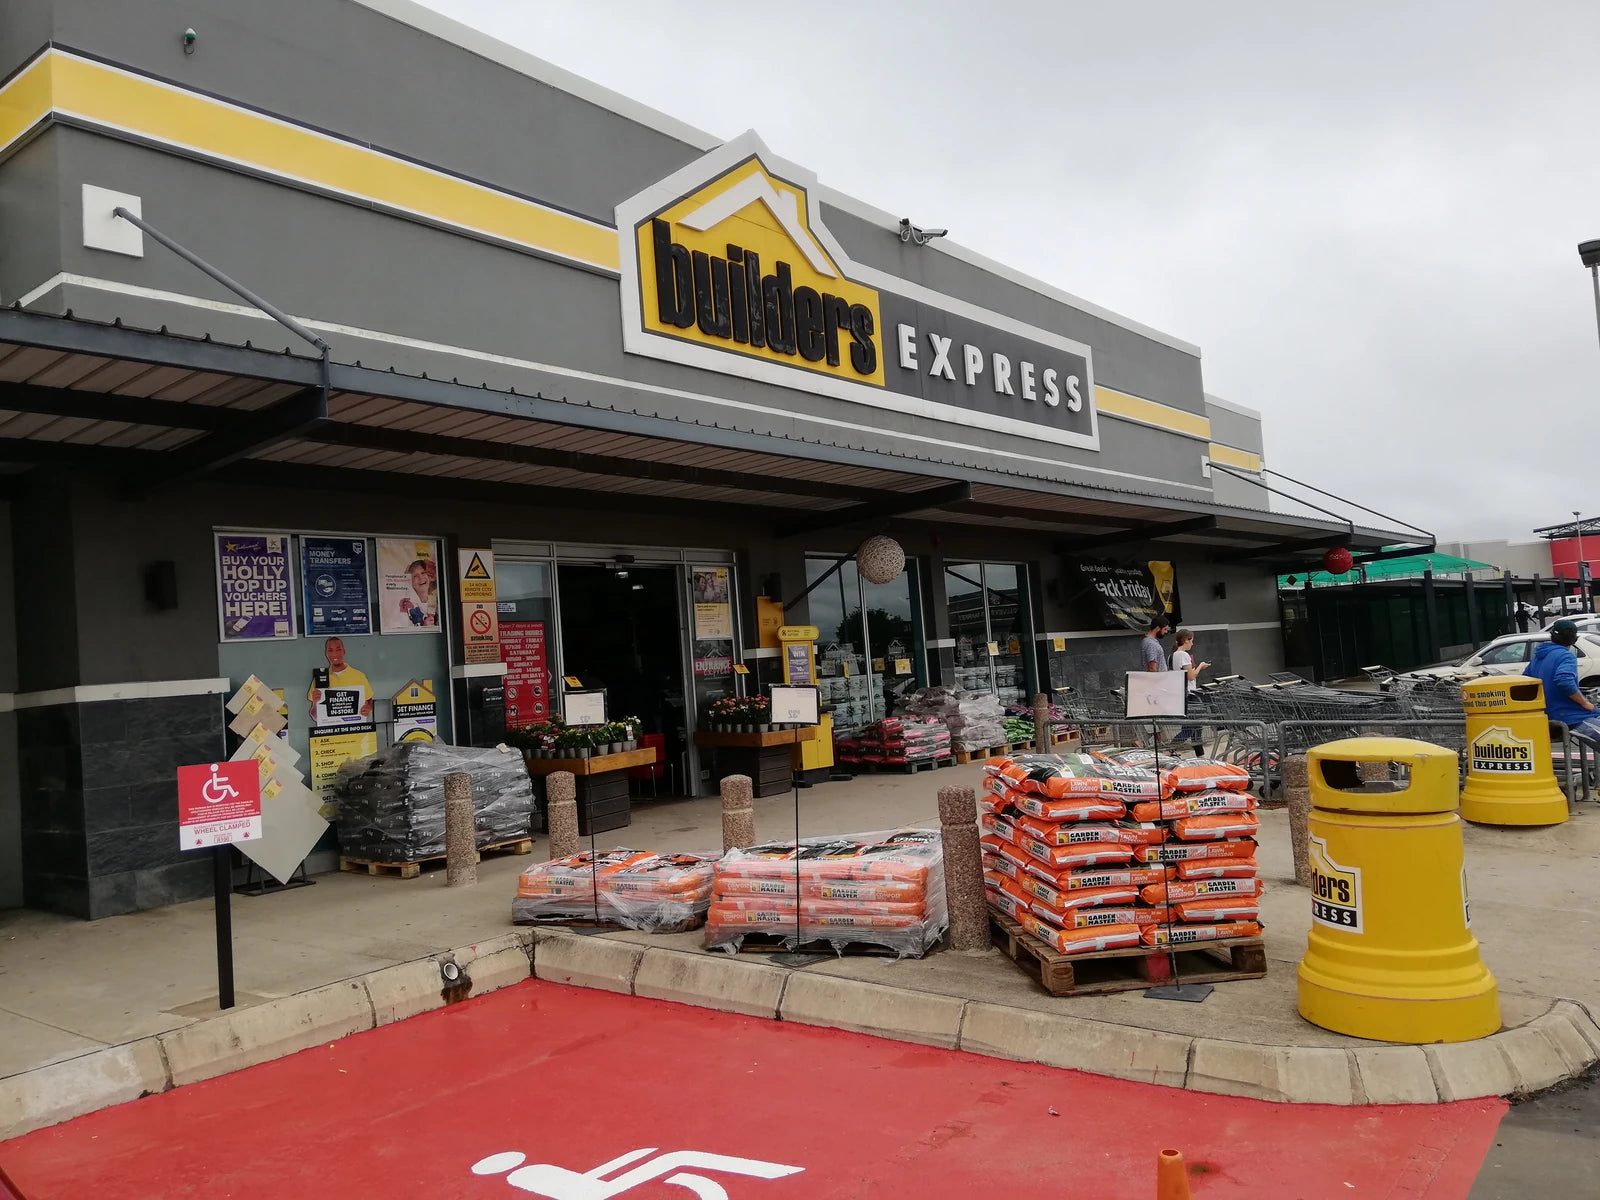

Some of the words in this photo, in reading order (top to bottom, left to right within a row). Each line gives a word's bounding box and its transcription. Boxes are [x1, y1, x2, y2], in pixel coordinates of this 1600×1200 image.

[652, 217, 877, 375] builders
[898, 323, 1083, 413] EXPRESS
[309, 550, 335, 558] MONEY
[222, 556, 248, 565] BUY
[251, 556, 285, 566] YOUR
[310, 557, 352, 565] TRANSFERS
[223, 565, 285, 580] HOLLY
[223, 579, 260, 592] TOP
[263, 579, 287, 592] UP
[1119, 579, 1152, 603] Friday
[224, 592, 288, 601] VOUCHERS
[225, 601, 288, 617] HERE!
[695, 660, 732, 672] ENTRANCE
[1476, 690, 1506, 699] smoking
[1489, 698, 1508, 707] point
[408, 704, 433, 712] FINANCE
[1474, 743, 1528, 759] builders
[1474, 761, 1530, 770] EXPRESS
[1112, 786, 1142, 794] MASTER
[1198, 796, 1226, 804] GARDEN
[193, 826, 218, 835] WHEEL
[219, 821, 251, 832] CLAMPED
[1081, 875, 1110, 883] GARDEN
[1310, 868, 1350, 903] ders
[1088, 913, 1116, 921] GARDEN
[1314, 902, 1352, 924] RESS
